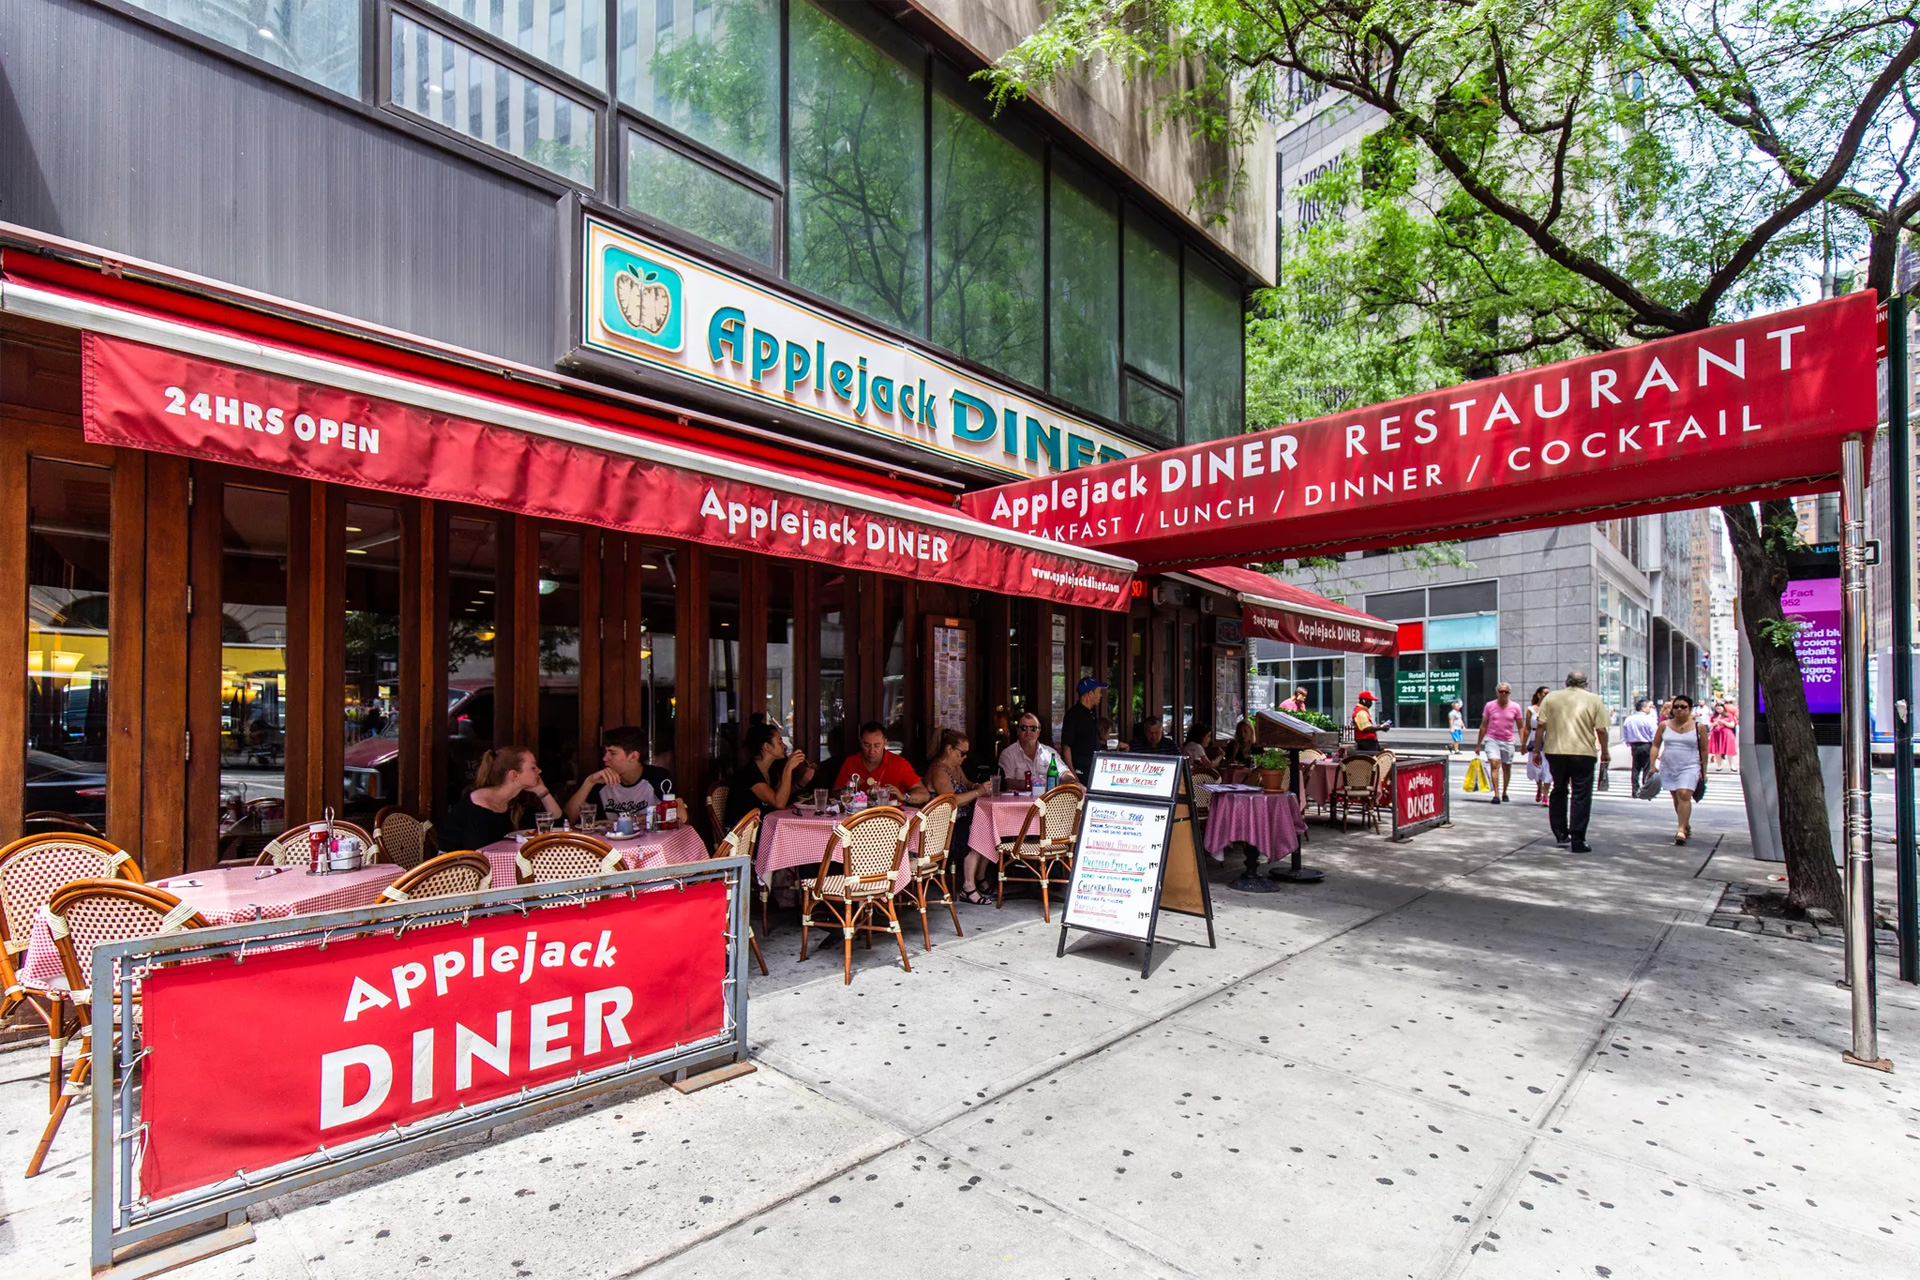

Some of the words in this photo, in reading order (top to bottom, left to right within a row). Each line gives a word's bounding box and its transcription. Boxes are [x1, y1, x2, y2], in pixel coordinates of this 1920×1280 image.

[706, 305, 938, 429] Applejack
[164, 386, 285, 435] 24HRS
[293, 413, 379, 454] OPEN
[991, 464, 1148, 528] Applejack
[1161, 434, 1298, 493] DINER
[1345, 324, 1806, 459] RESTAURANT
[1160, 495, 1254, 528] LUNCH
[1305, 464, 1443, 506] DINNER
[1507, 405, 1762, 472] COCKTAIL
[700, 487, 857, 546] Applejack
[866, 521, 949, 563] DINER
[1298, 619, 1337, 643] Applejack
[1337, 625, 1361, 642] DINER
[1795, 647, 1836, 656] seball's
[1401, 685, 1416, 693] 212
[1436, 684, 1456, 692] 1041
[1806, 674, 1832, 683] NYC
[1408, 772, 1433, 792] Applejack
[1407, 793, 1435, 819] DINER
[1078, 880, 1107, 893] CHICKEN
[343, 929, 618, 1023] Applejack
[319, 985, 633, 1131] DINER
